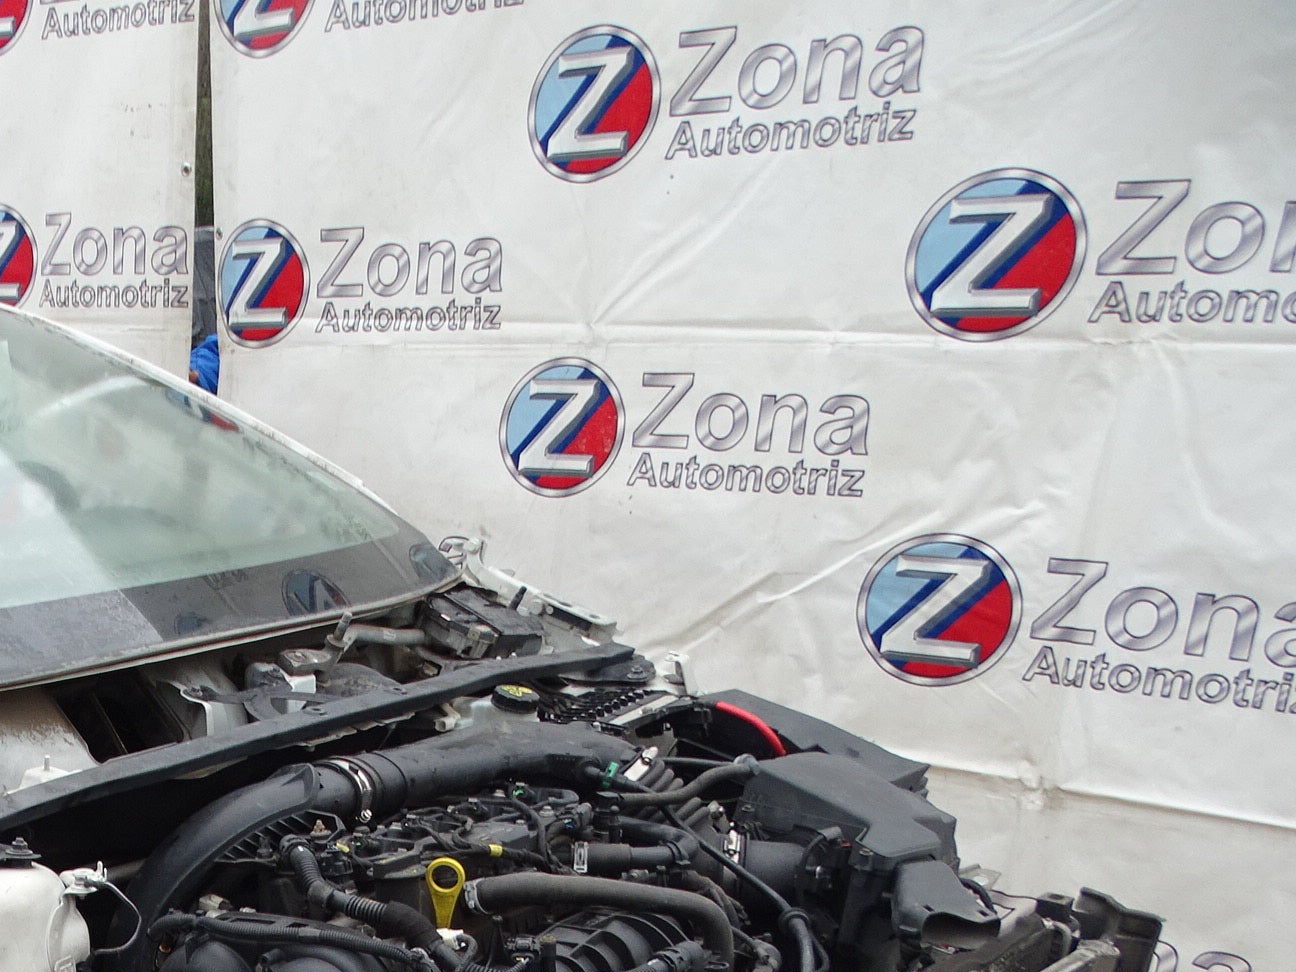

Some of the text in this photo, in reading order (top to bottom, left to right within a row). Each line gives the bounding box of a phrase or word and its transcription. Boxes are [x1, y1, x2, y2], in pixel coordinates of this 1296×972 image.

[41, 0, 195, 40] Automotriz
[325, 0, 524, 32] Automo
[669, 25, 925, 117] Zona
[665, 101, 917, 160] Automotriz
[40, 211, 189, 276] Zona
[1095, 179, 1296, 275] Zo
[317, 226, 503, 298] Zona
[38, 278, 190, 308] Automotriz
[315, 297, 502, 333] Automotriz
[1087, 279, 1296, 323] Autom
[632, 372, 870, 457] Zona
[627, 452, 865, 498] Automotriz
[1022, 646, 1296, 715] Automotri
